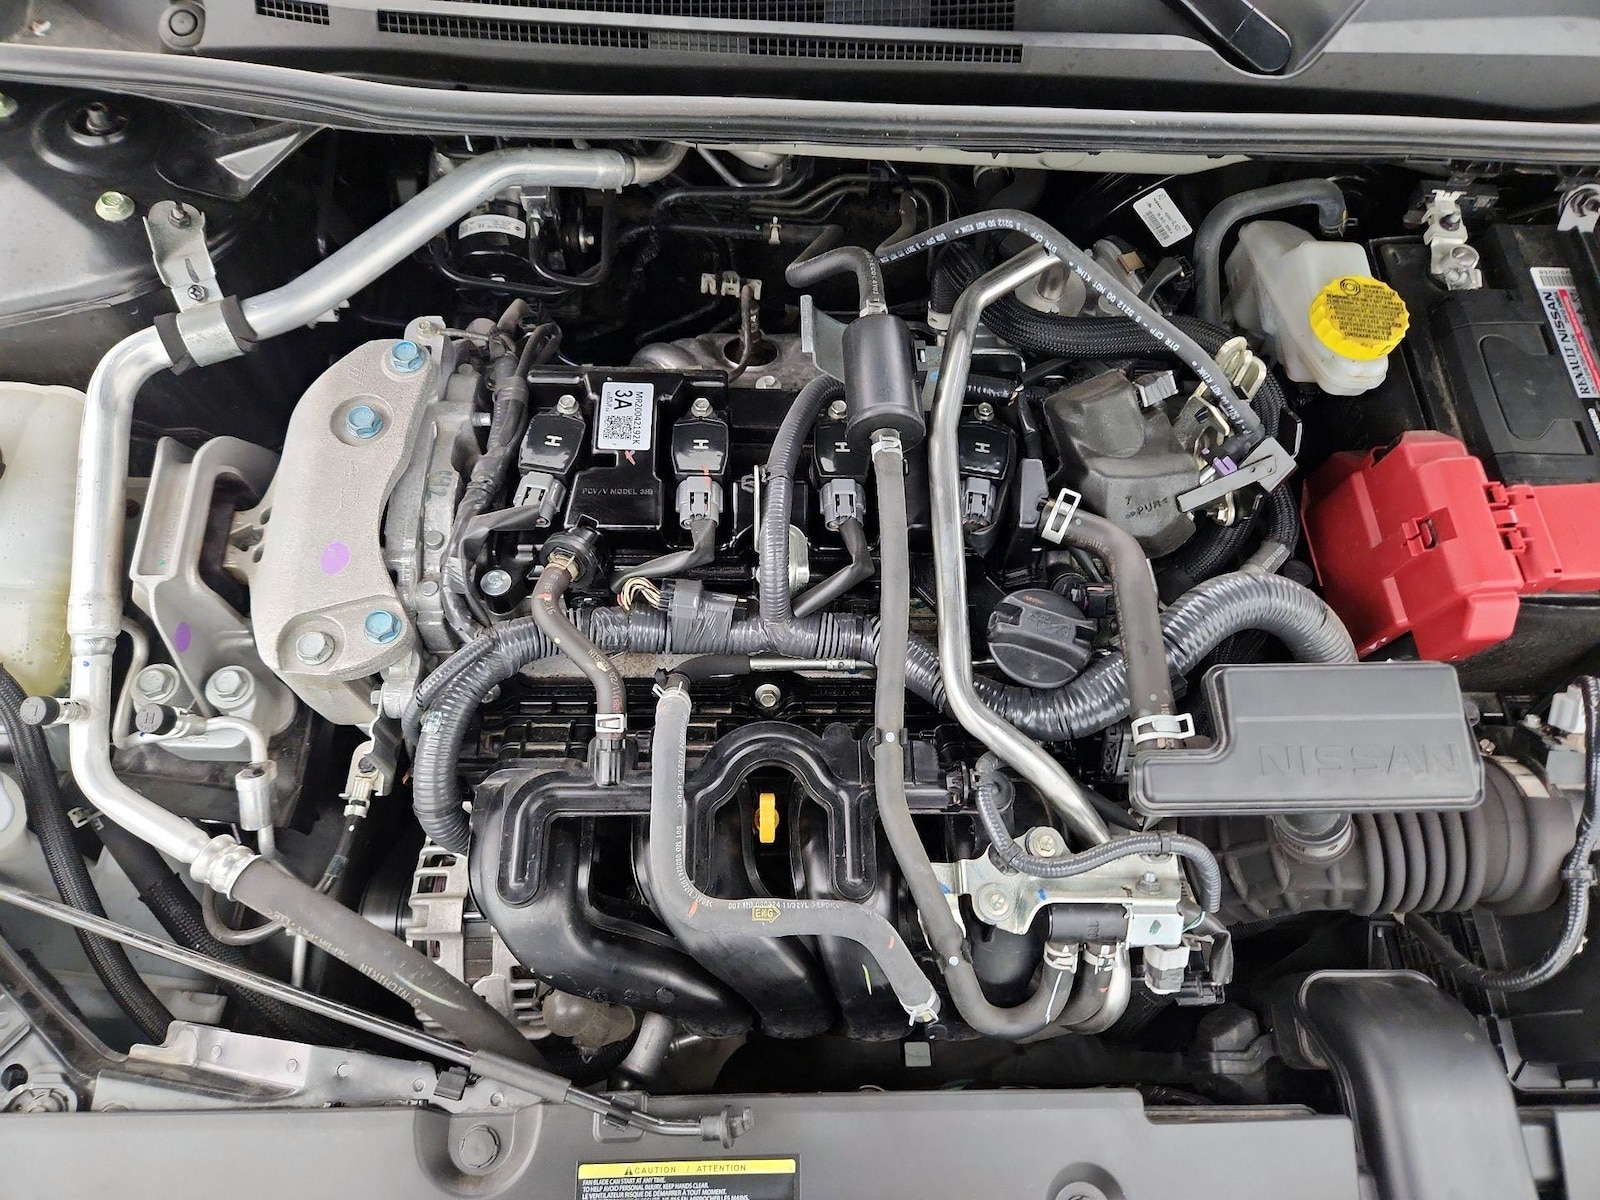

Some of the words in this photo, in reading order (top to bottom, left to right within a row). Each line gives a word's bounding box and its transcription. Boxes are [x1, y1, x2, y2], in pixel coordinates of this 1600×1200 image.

[1075, 266, 1092, 282] KINK
[1542, 291, 1571, 343] NISSAN
[1150, 328, 1164, 339] CFP
[1165, 338, 1180, 352] DTR
[1564, 347, 1590, 395] RENAULT
[613, 389, 633, 410] 3A
[1258, 742, 1460, 777] NISSAN
[755, 909, 774, 918] ENG
[359, 963, 410, 999] NICHIRIN
